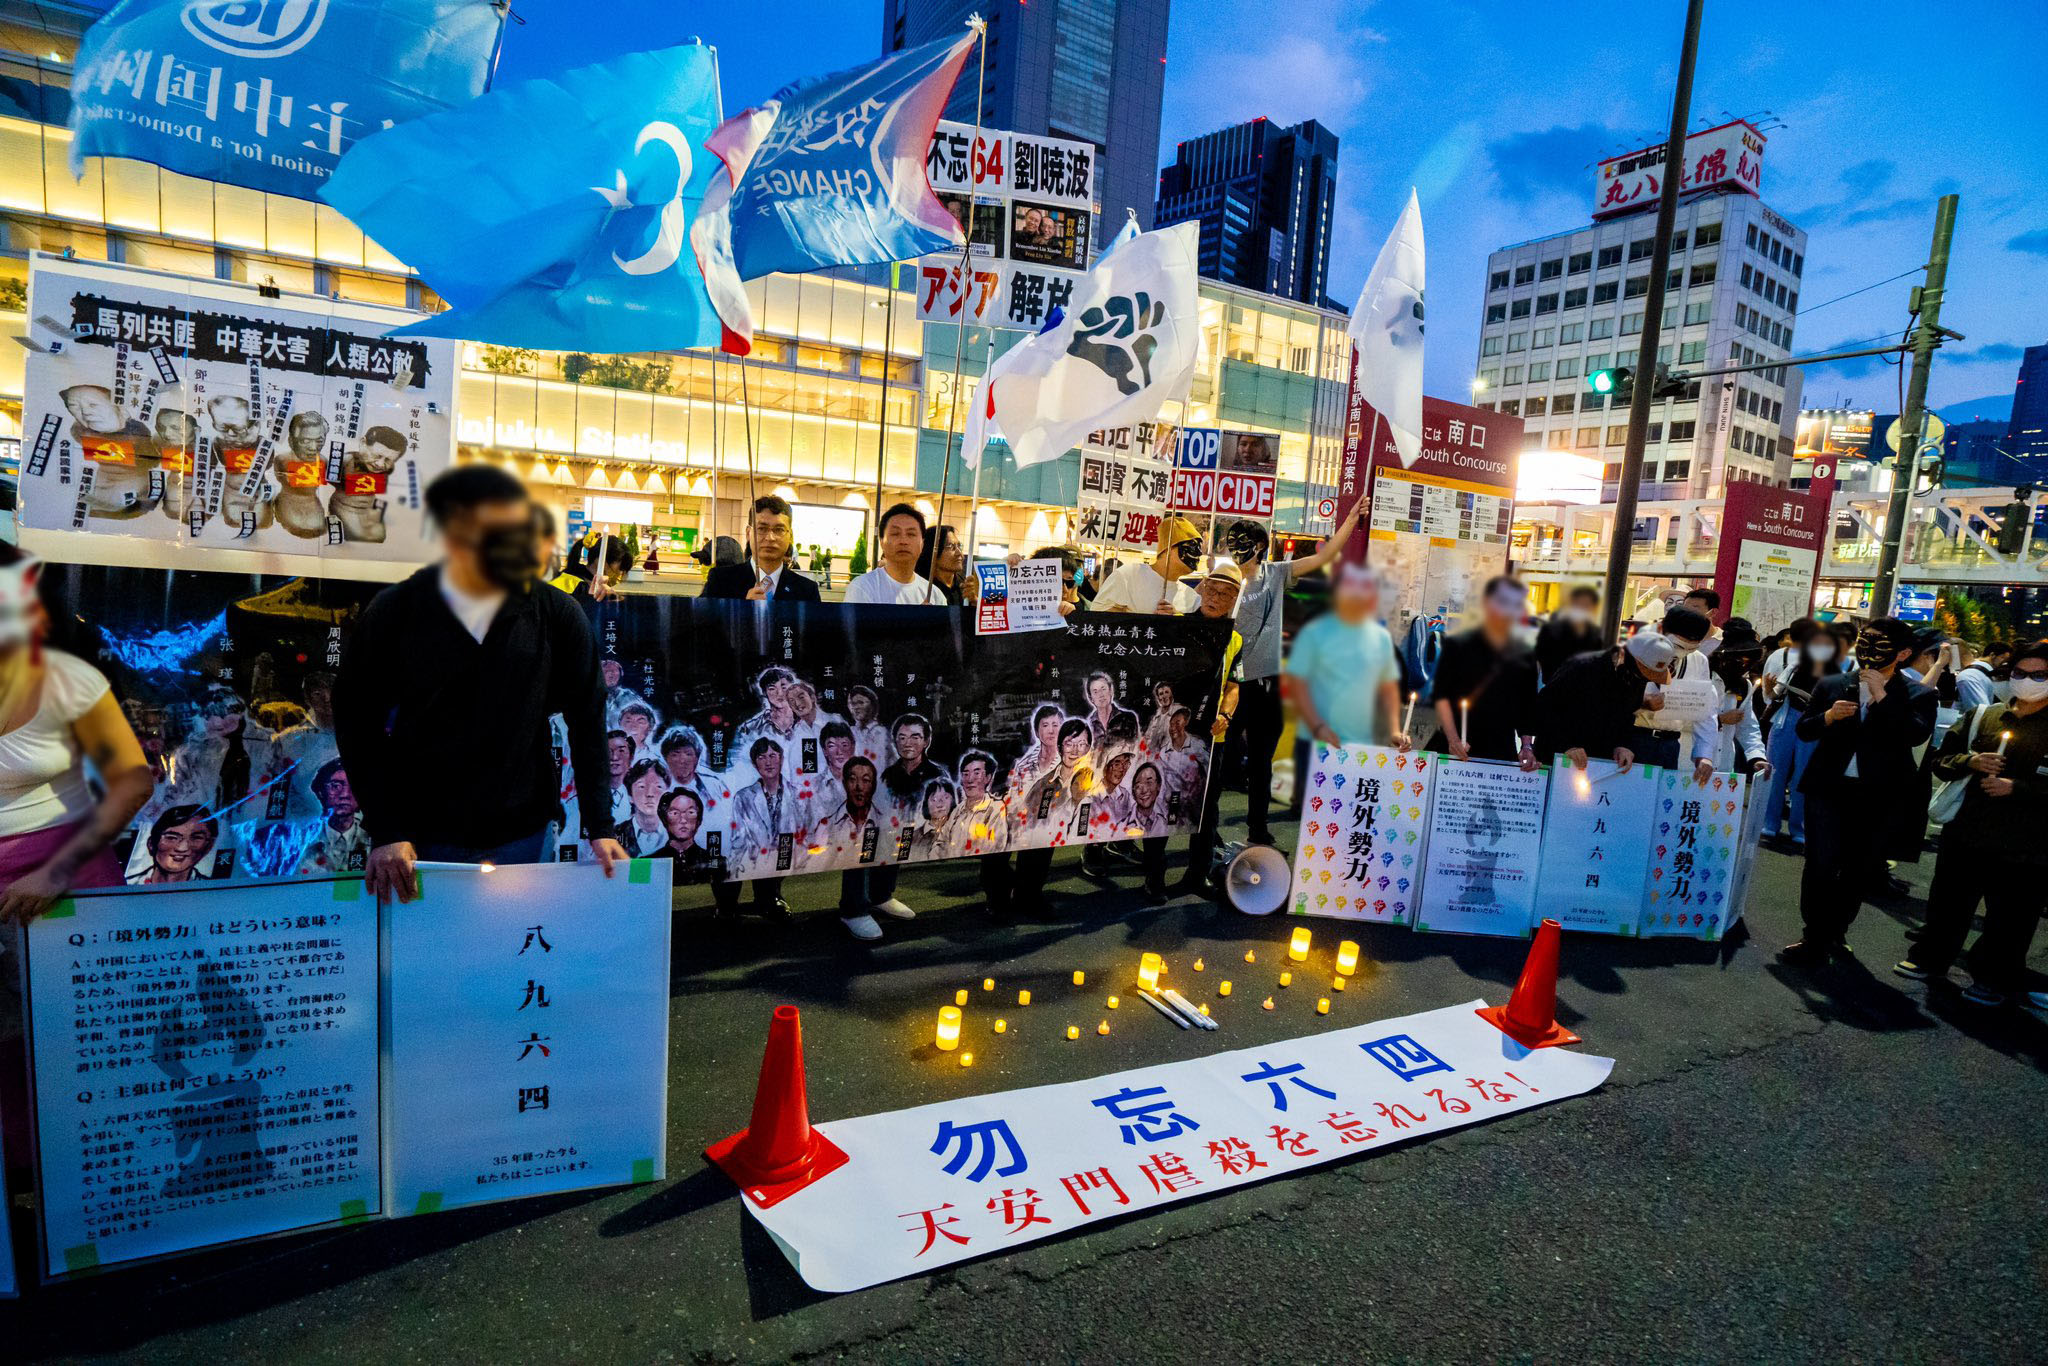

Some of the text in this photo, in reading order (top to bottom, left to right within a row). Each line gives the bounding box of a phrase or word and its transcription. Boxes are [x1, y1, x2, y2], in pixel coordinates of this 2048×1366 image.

[922, 266, 999, 319] アジア
[96, 308, 196, 350] 馬列共匪
[217, 325, 310, 365] 中華大害
[1170, 429, 1218, 467] TOP
[1425, 419, 1487, 449] こは 南口
[1453, 451, 1508, 475] Concourse
[1781, 502, 1804, 523] 南口
[1763, 521, 1782, 535] South
[1783, 524, 1814, 540] Concourse
[984, 575, 1006, 590] 六四
[1010, 565, 1056, 578] 勿忘六四
[326, 627, 341, 666] 周欣明
[605, 621, 617, 655] 王培文
[1066, 624, 1158, 640] 定格热血青春
[1098, 643, 1186, 657] 纪念八九六四
[643, 664, 655, 697] 杜光学
[970, 713, 980, 744] 陆春林
[713, 730, 724, 765] 杨振江
[803, 741, 816, 772] 赵龙
[1343, 778, 1381, 882] 境外勢力
[1585, 791, 1610, 889] 八九六四
[1668, 801, 1701, 900] 境外勢力
[517, 925, 553, 1114] 八九六四
[930, 1034, 1455, 1184] 勿忘六四
[898, 1071, 1541, 1259] 天安門虐殺を忘れるな！
